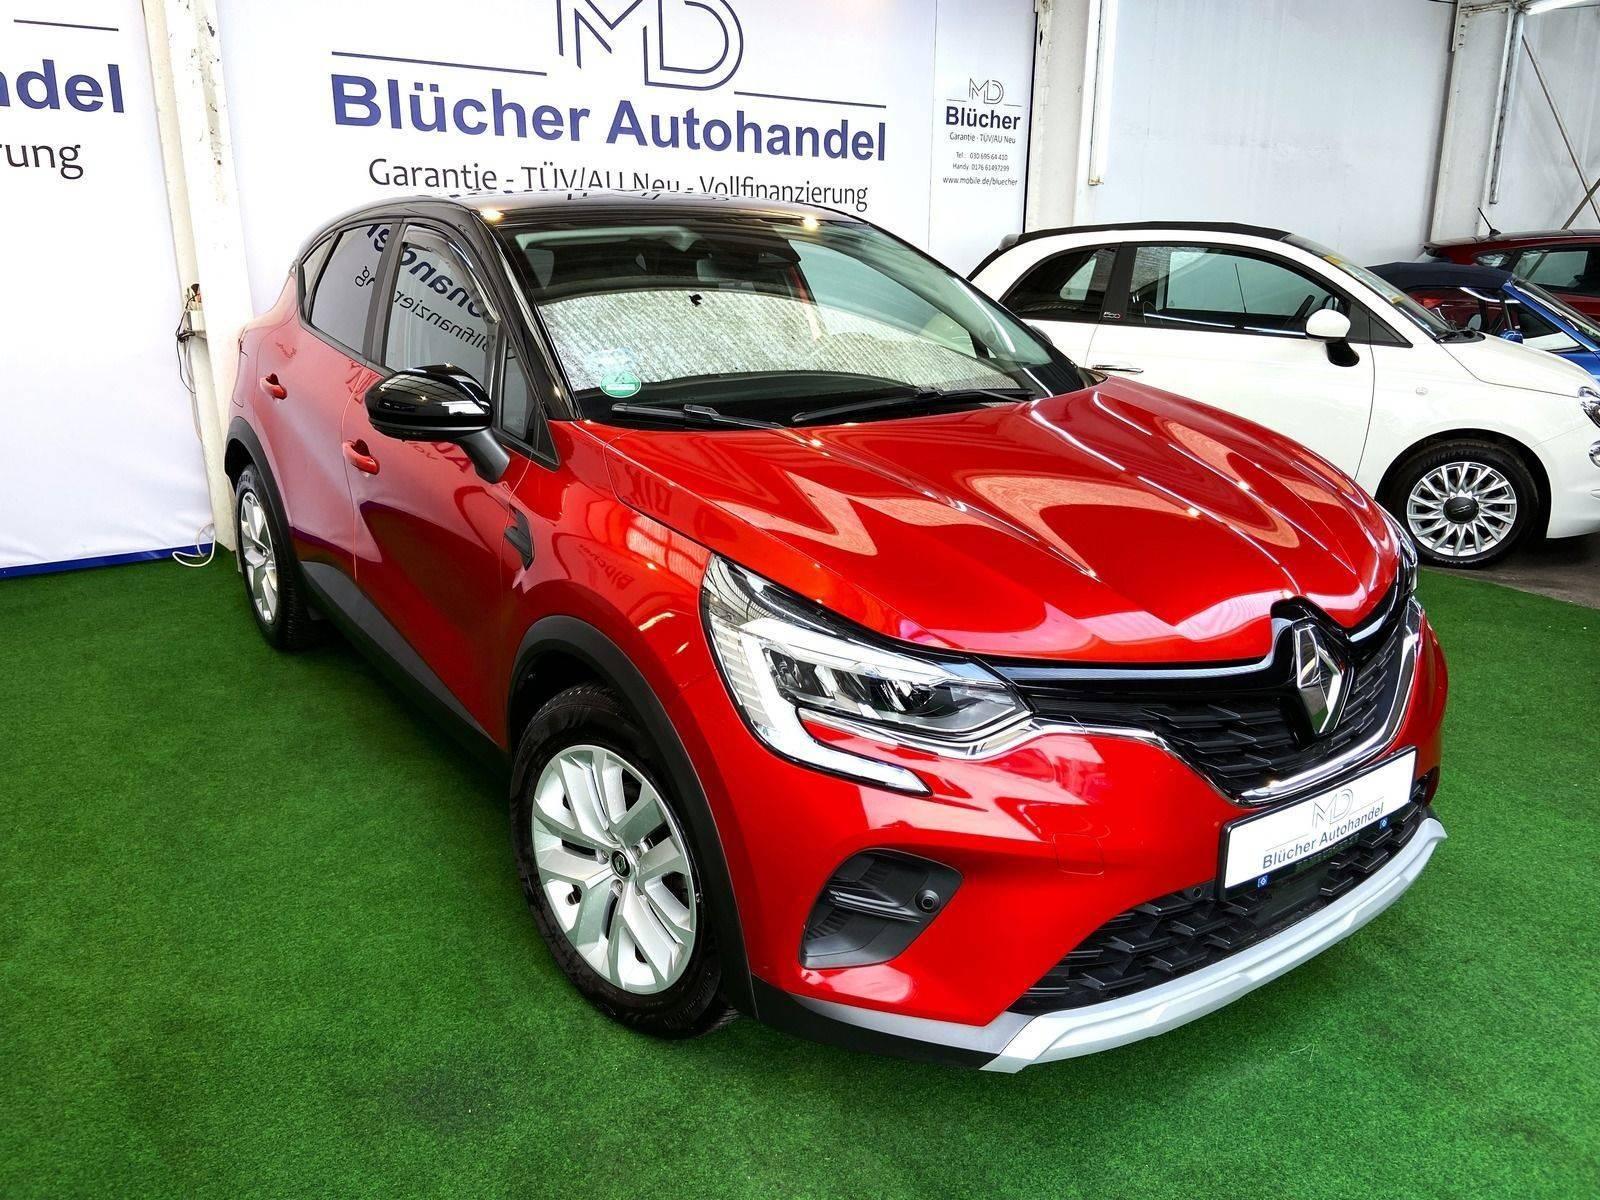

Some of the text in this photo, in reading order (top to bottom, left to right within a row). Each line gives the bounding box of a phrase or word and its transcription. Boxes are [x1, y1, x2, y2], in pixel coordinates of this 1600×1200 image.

[330, 73, 887, 162] Blücher Autohandel
[946, 106, 1021, 130] Blücher
[949, 132, 975, 142] Garantie
[1004, 135, 1016, 144] Neu
[0, 144, 84, 180] ung
[368, 158, 497, 190] Garantie
[699, 175, 868, 213] Vollfinanzierung
[942, 177, 1018, 187] www.mobile.de/bluecher
[1262, 839, 1317, 870] Blücher
[1318, 802, 1385, 847] Autohandel
